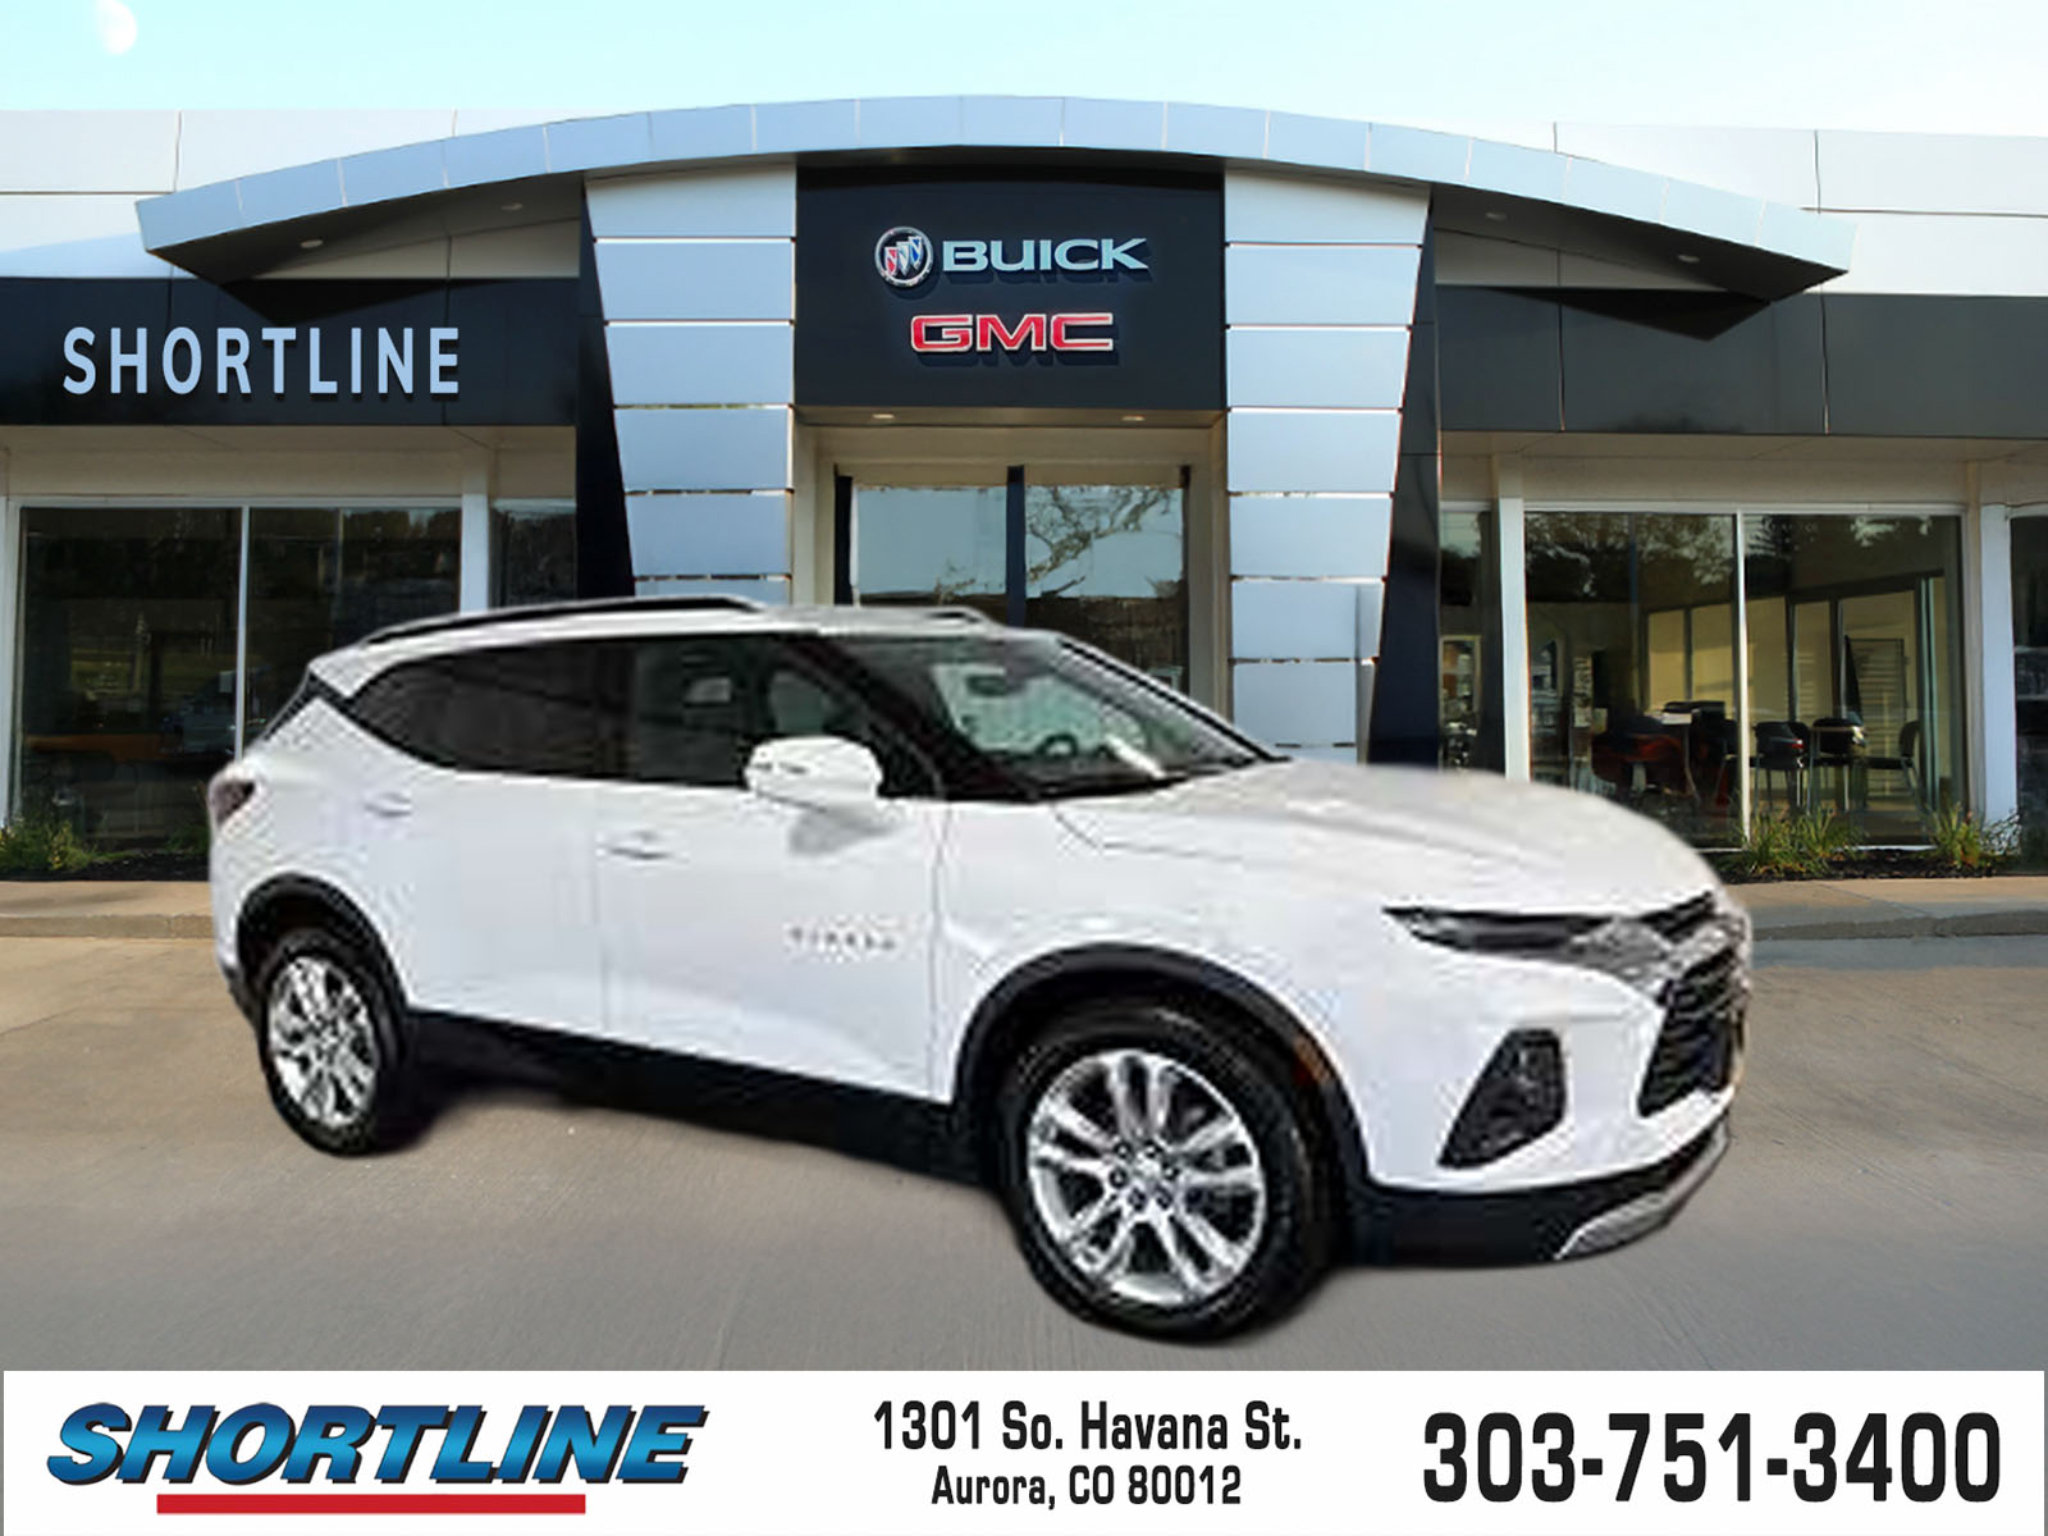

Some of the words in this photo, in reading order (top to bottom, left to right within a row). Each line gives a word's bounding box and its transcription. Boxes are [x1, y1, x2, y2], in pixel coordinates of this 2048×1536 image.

[942, 238, 1149, 272] BUICK
[910, 312, 1115, 353] GMC
[63, 326, 460, 395] SHORTLINE
